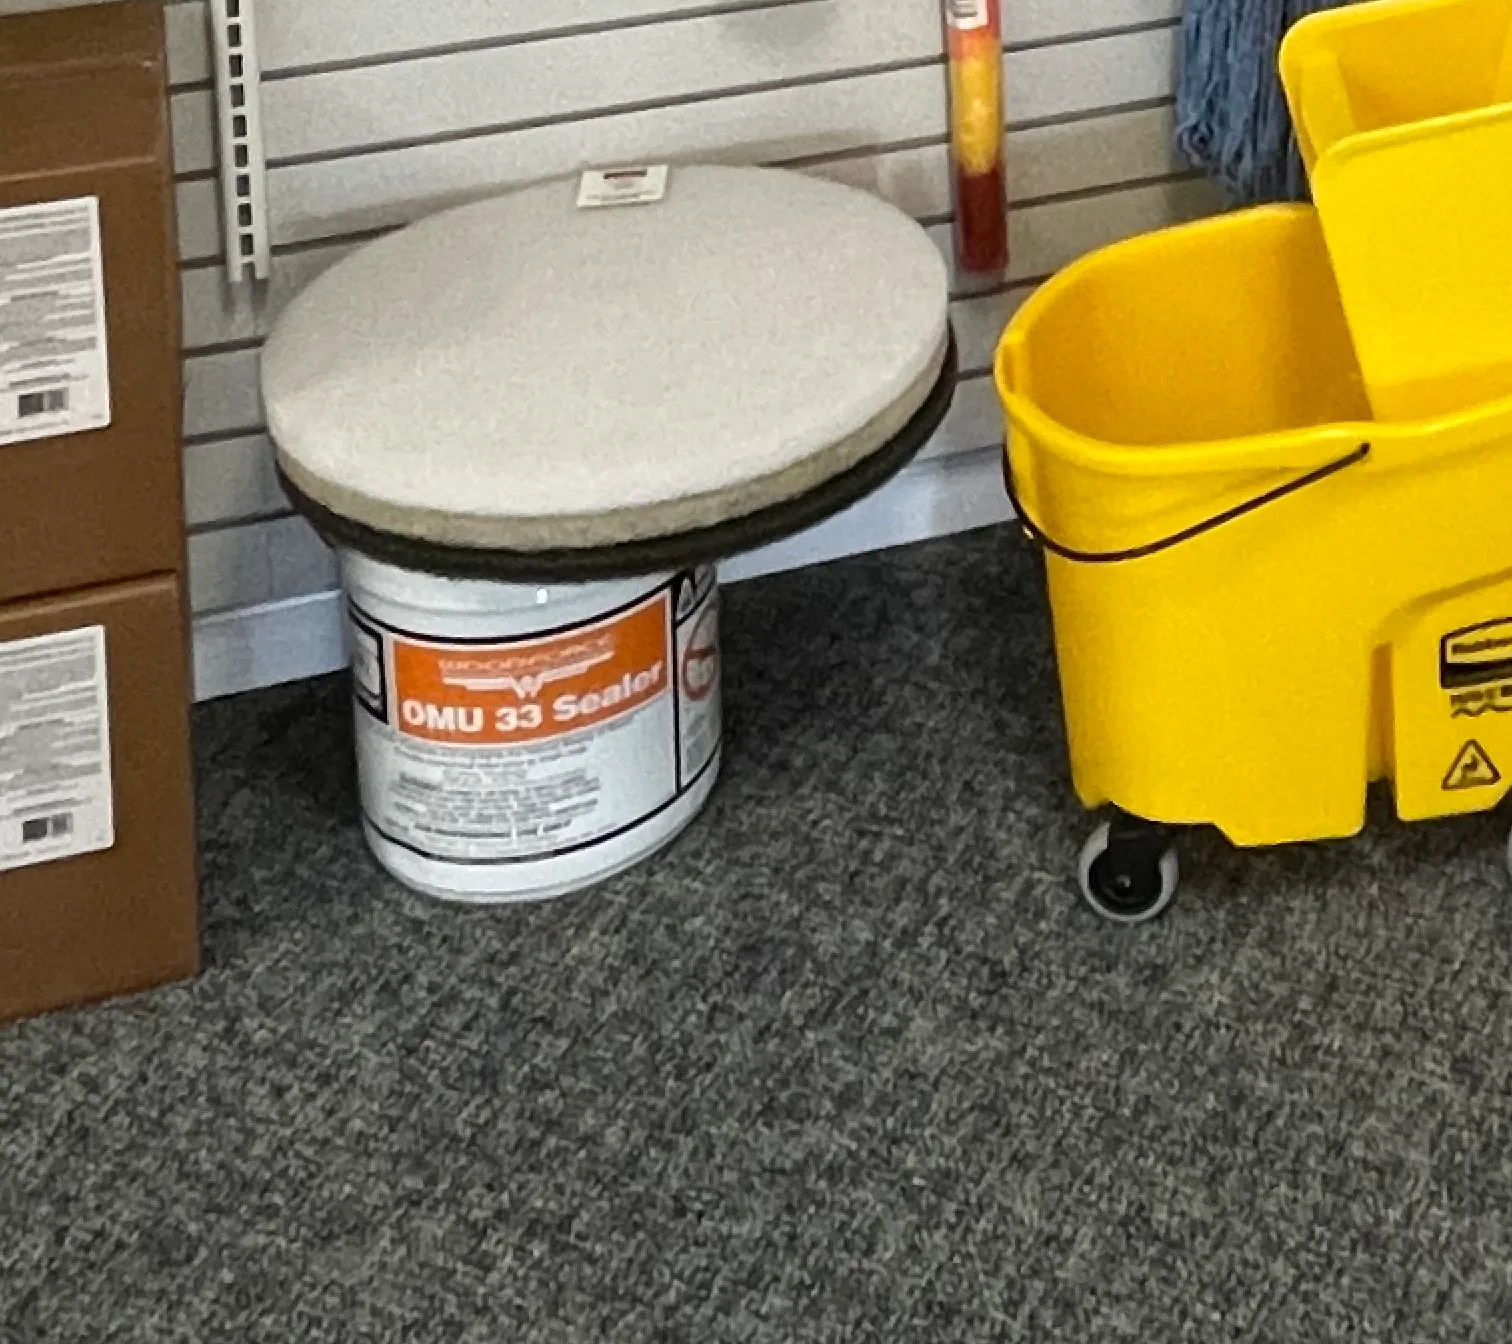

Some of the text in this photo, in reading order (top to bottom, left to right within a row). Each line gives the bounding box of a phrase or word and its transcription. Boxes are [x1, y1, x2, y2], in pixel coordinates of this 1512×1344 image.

[402, 659, 664, 732] OMU 33 Sealer
